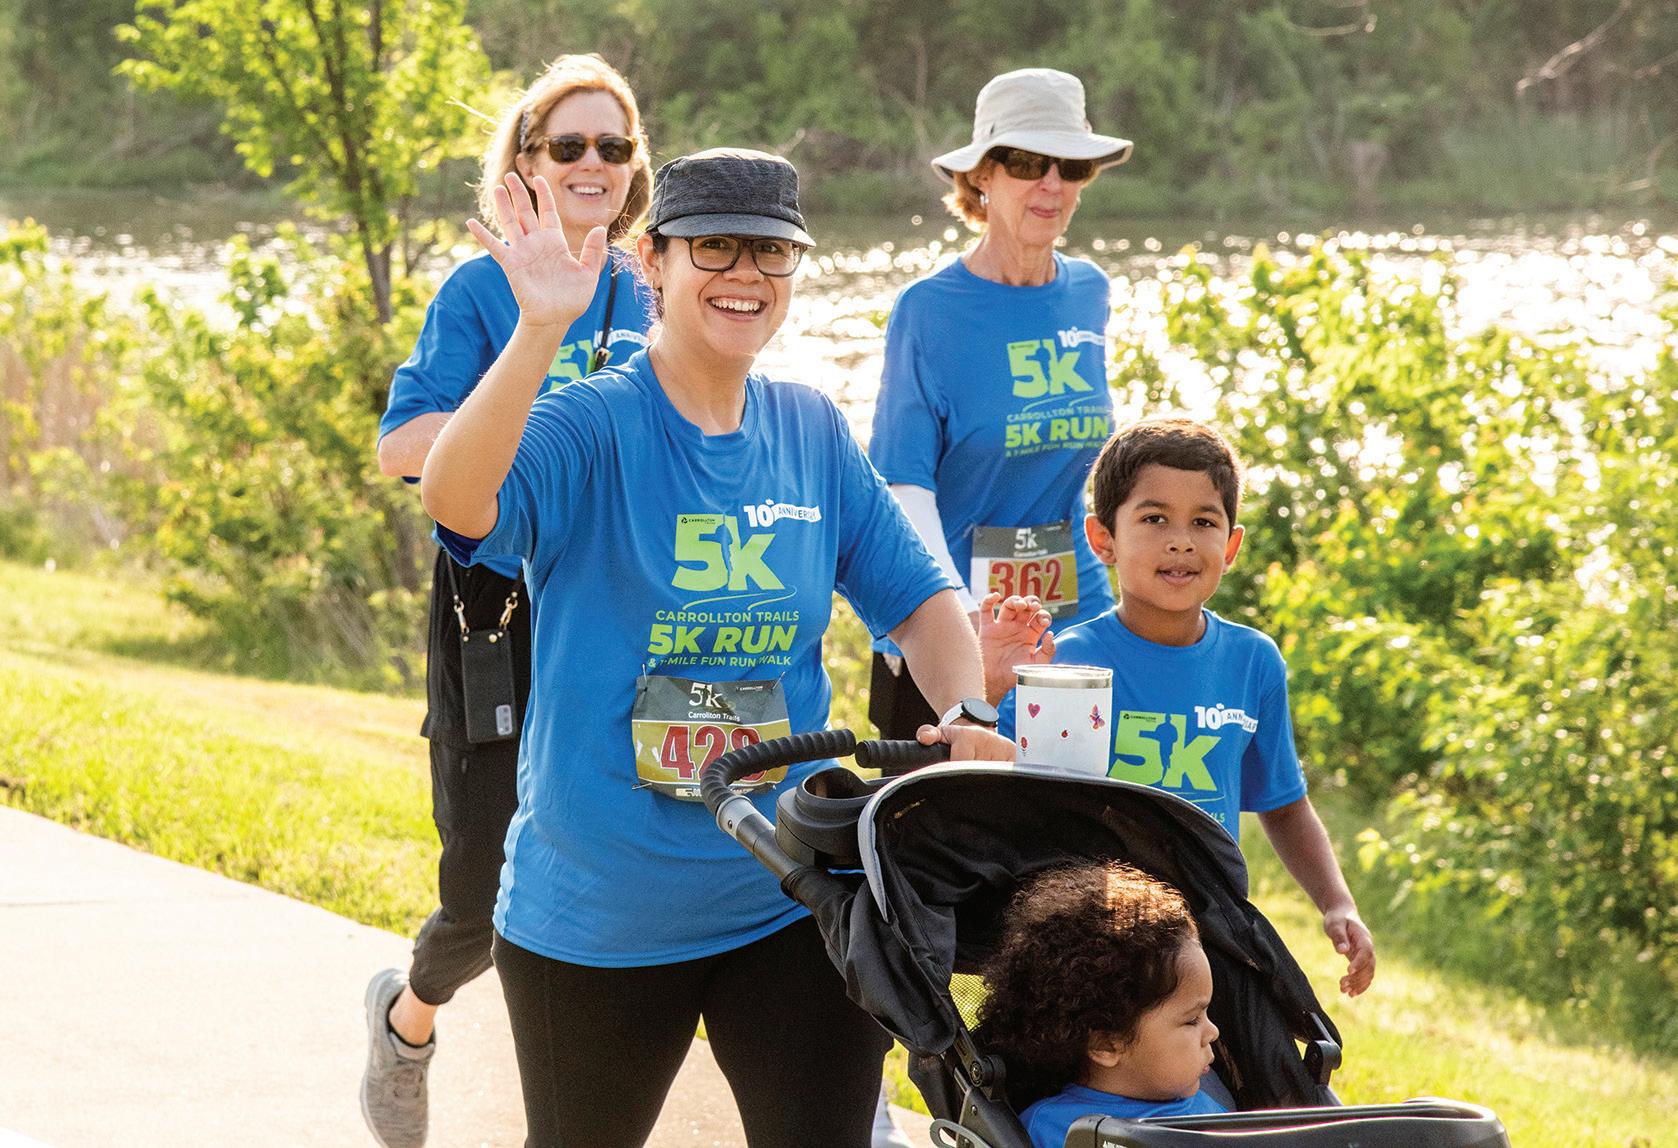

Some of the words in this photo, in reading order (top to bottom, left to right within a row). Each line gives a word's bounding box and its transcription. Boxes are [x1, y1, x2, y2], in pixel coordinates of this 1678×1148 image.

[1005, 422, 1042, 448] 5K
[1049, 416, 1109, 441] RUN
[990, 559, 1062, 604] 362
[655, 610, 752, 623] CARROLLTON
[756, 610, 799, 622] TRAILS
[647, 623, 706, 655] 5K
[712, 624, 798, 654] RUN
[648, 657, 656, 668] &
[700, 656, 726, 666] FUN
[722, 712, 741, 722] Trails
